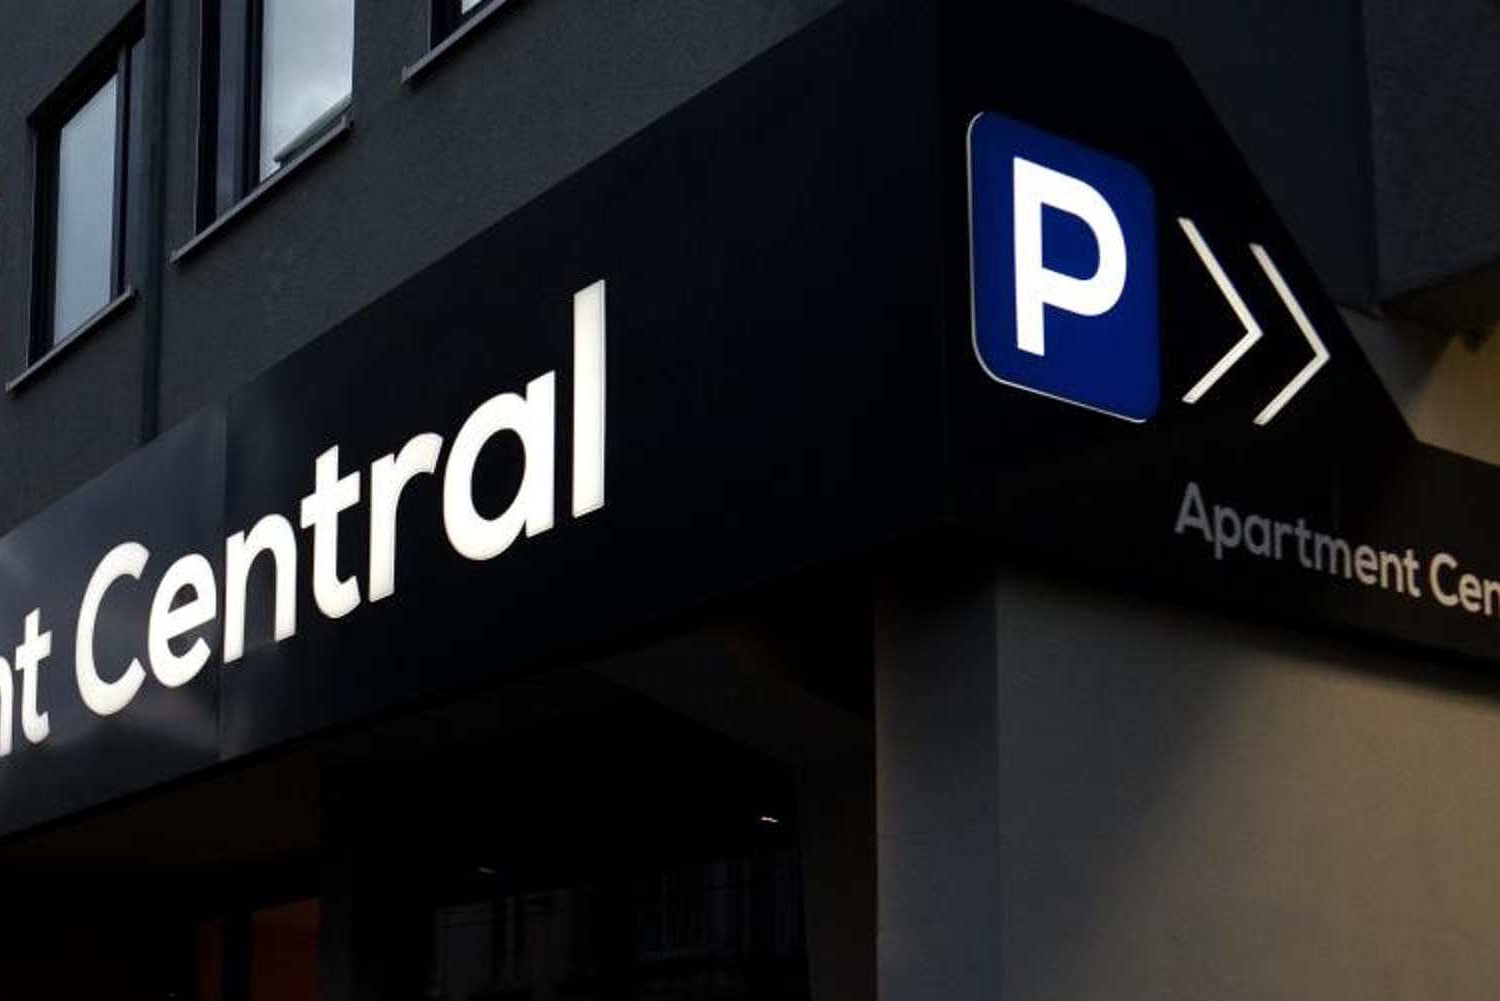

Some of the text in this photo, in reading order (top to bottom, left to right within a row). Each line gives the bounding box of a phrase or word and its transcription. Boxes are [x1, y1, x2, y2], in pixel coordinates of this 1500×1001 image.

[1012, 155, 1128, 357] P
[75, 278, 607, 716] Central
[1173, 480, 1422, 599] Apartment
